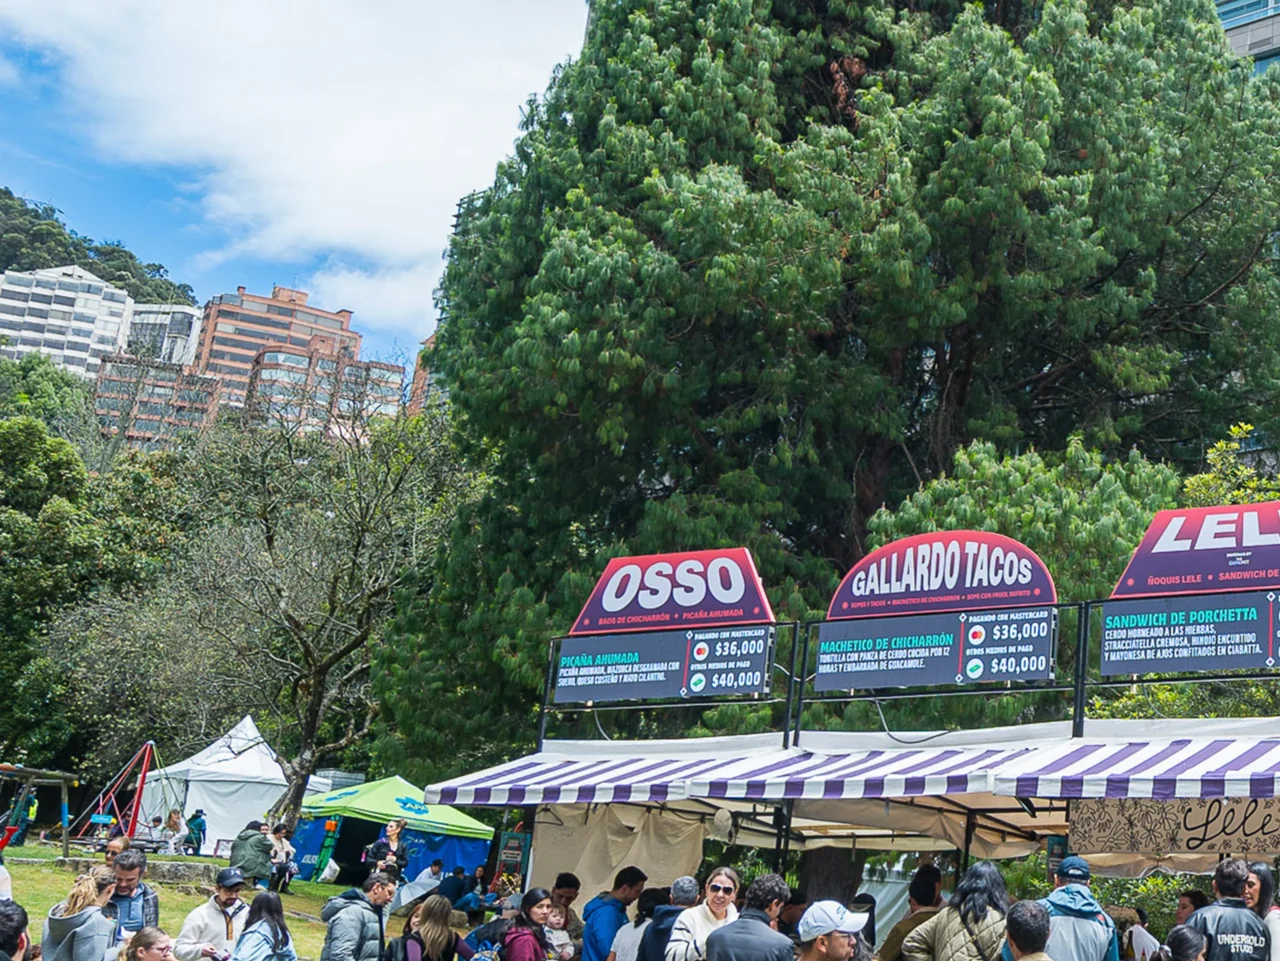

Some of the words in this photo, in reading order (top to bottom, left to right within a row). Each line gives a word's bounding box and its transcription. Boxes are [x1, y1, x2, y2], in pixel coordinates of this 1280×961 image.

[852, 540, 961, 597] GALLARDO
[965, 541, 1032, 588] TACOS
[1219, 570, 1266, 581] SANDWICH
[602, 557, 745, 612] OSSO
[1182, 575, 1201, 583] LELE
[710, 609, 743, 617] AHUMADA
[1106, 613, 1166, 628] SANDWICH
[1171, 612, 1185, 624] DE
[1190, 608, 1257, 623] PORCHETTA
[993, 622, 1047, 640] $36,000
[715, 640, 764, 656] $36,000
[821, 640, 872, 653] MACHETICO
[876, 639, 888, 649] DE
[892, 634, 953, 648] CHICHARRÓN
[561, 656, 592, 666] PICAÑA
[595, 653, 638, 664] AHUMADA
[991, 656, 1046, 674] $40,000
[712, 671, 760, 690] $40,000
